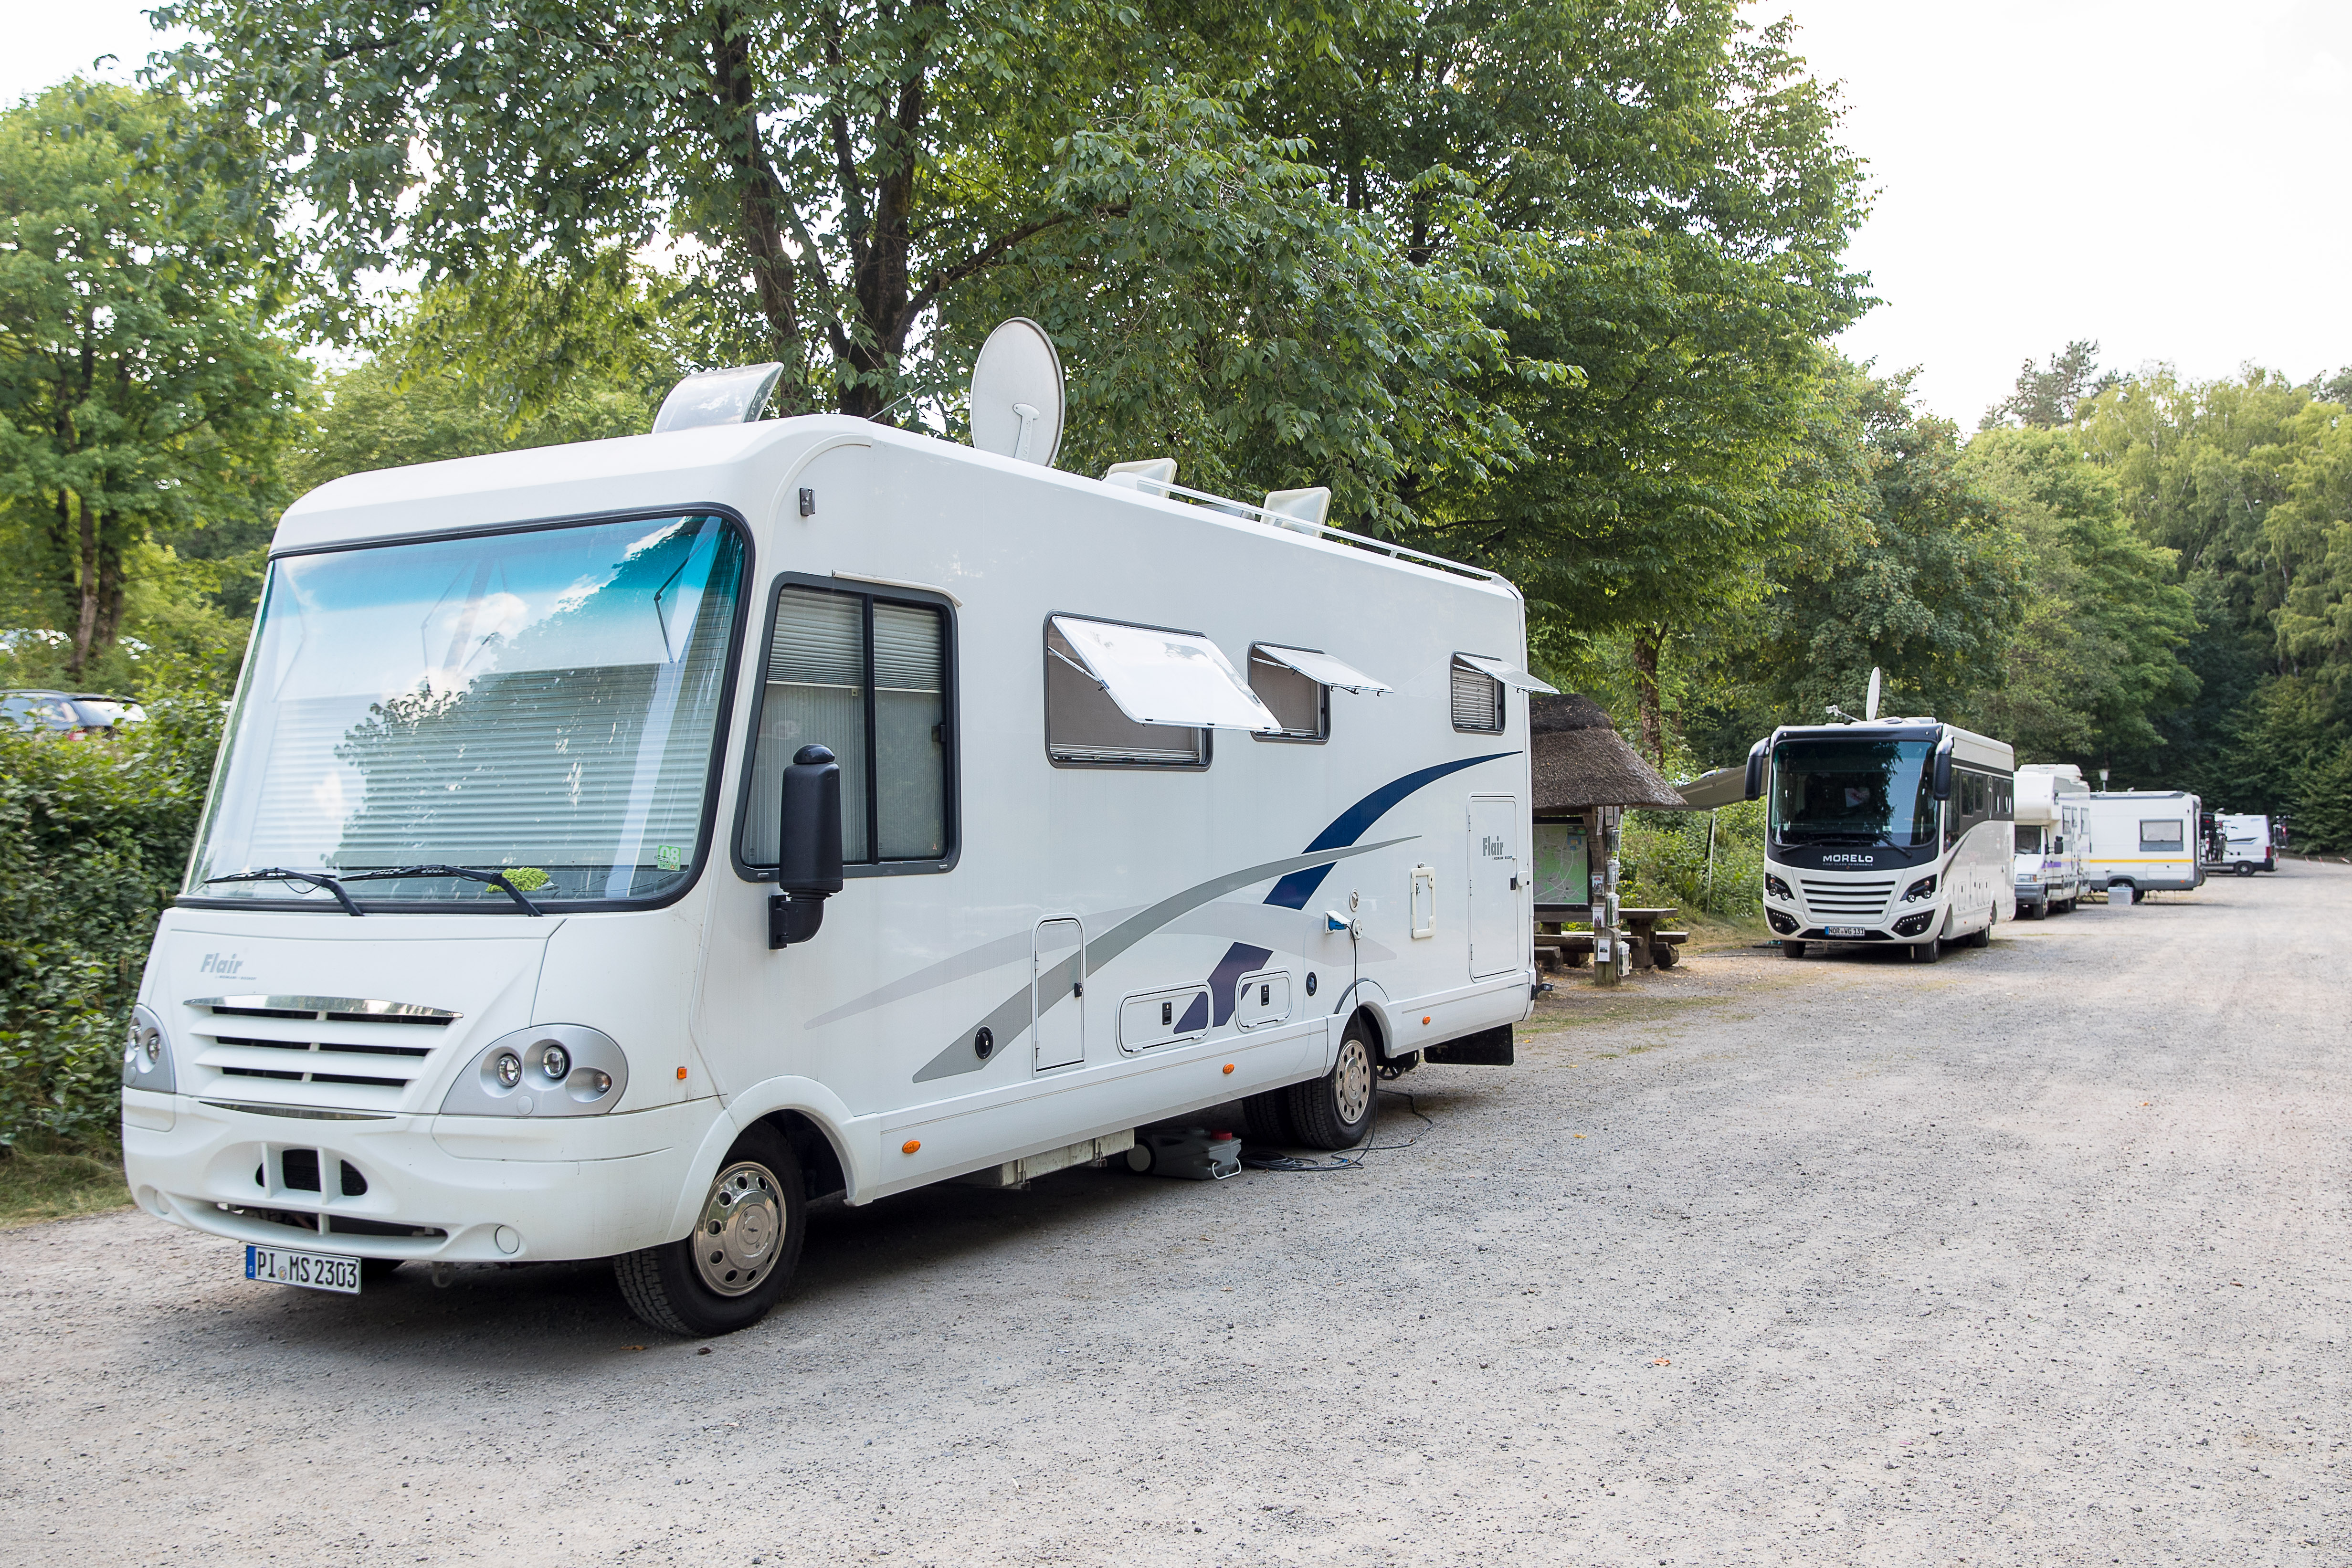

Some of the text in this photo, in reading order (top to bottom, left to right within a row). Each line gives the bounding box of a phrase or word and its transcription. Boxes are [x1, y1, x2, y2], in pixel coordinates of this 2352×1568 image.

[660, 846, 679, 863] 08
[1483, 835, 1504, 856] Flair
[1823, 854, 1873, 863] MORELO
[200, 953, 243, 974] Flair
[258, 1251, 357, 1288] PI MS 2303
